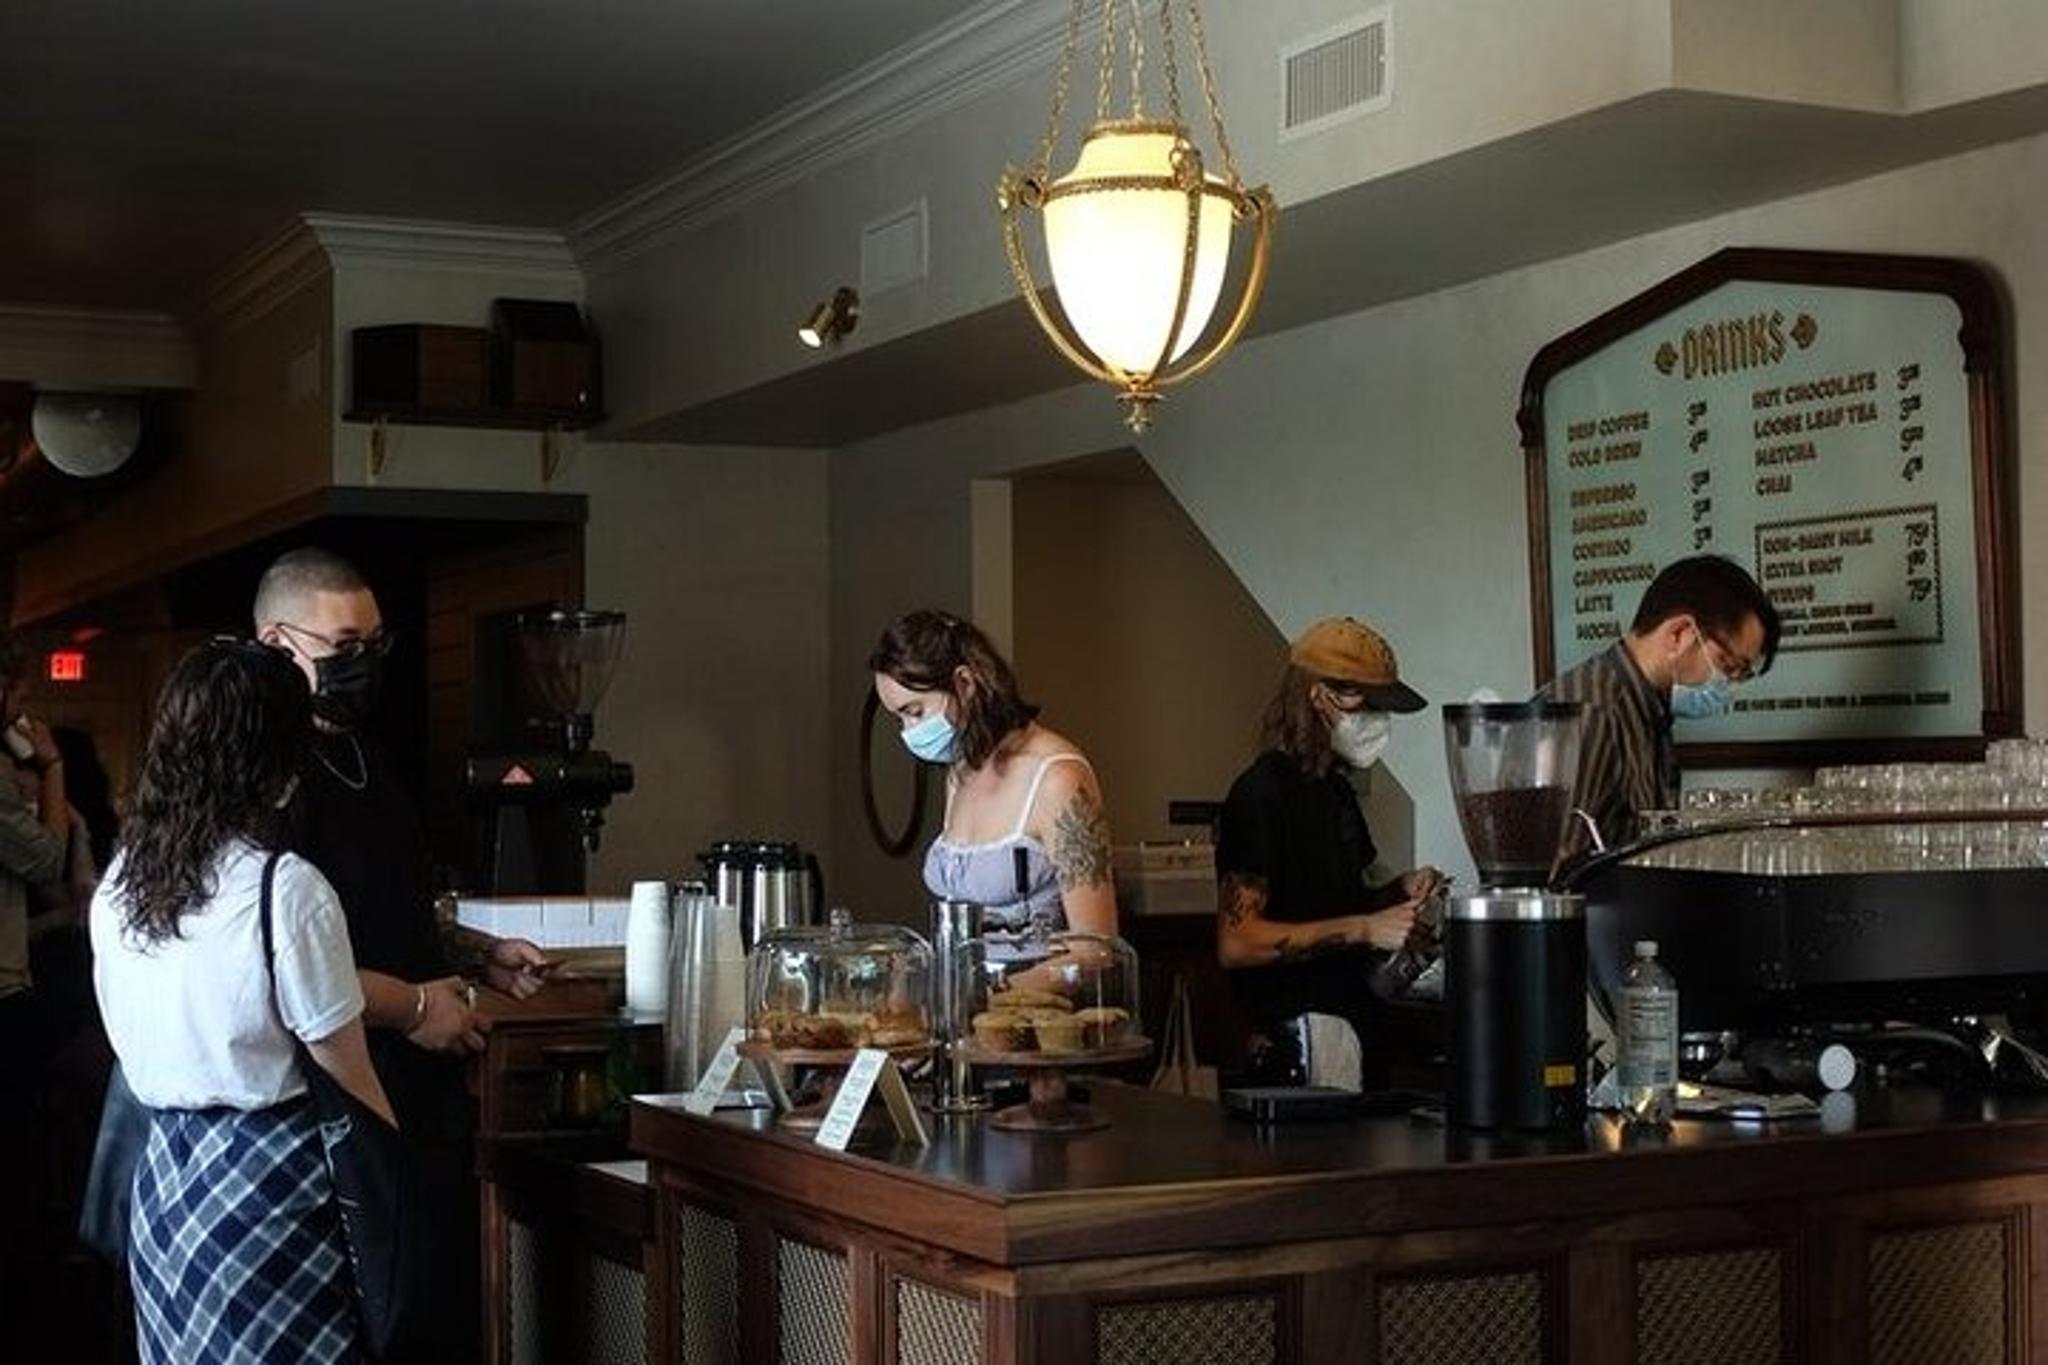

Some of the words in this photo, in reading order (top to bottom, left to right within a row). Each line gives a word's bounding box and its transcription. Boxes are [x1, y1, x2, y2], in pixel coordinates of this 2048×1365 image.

[1682, 310, 1785, 380] DRINKS
[1752, 388, 1781, 410] HOT
[1784, 372, 1877, 404] CHOCOLATE
[1599, 412, 1649, 437] COFFEE
[1754, 413, 1803, 439] LOOSE
[1805, 406, 1844, 430] LEAF
[1845, 402, 1878, 425] TEA
[1568, 448, 1601, 468] COLD
[1604, 441, 1642, 464] BREW
[1755, 442, 1817, 466] MATCHA
[1756, 474, 1792, 496] CHAI
[1573, 537, 1631, 561] CORTADO
[1839, 527, 1874, 547] MILK
[1573, 563, 1656, 588] CAPPUCCINO
[1765, 560, 1806, 580] EXTRA
[1809, 556, 1843, 575] SHOT
[1575, 594, 1614, 614] LATTE
[1576, 620, 1622, 640] MOCHA
[51, 653, 84, 681] EXIT
